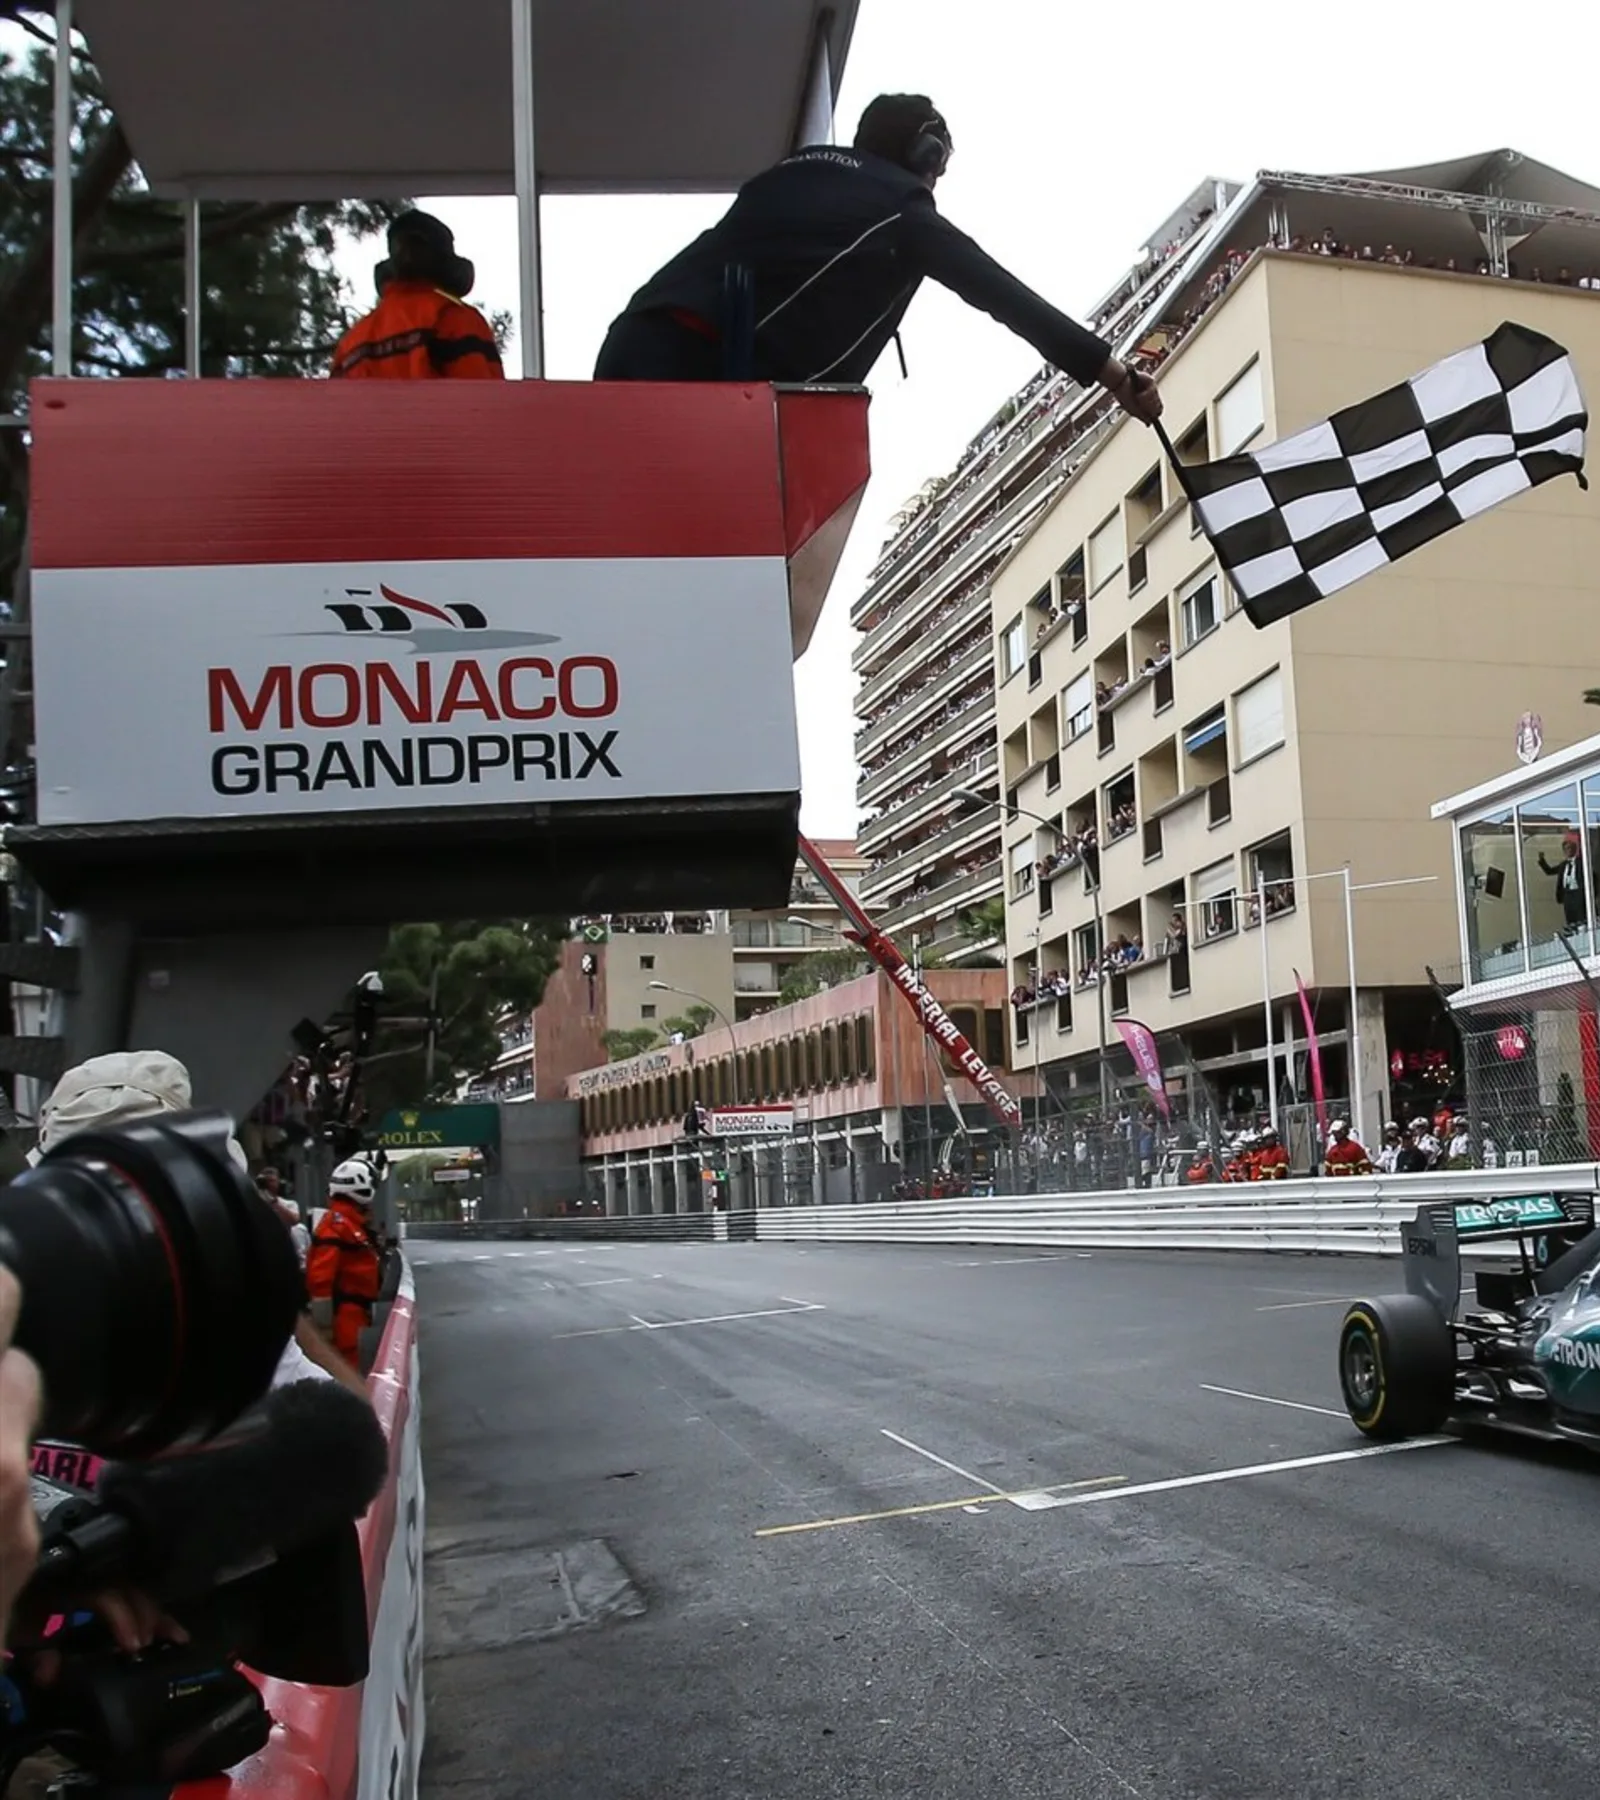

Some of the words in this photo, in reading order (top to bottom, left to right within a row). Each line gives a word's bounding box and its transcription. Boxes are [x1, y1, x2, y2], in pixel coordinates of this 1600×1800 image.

[207, 655, 619, 733] MONACO
[211, 730, 622, 795] GRANDPRIX
[894, 963, 962, 1047] IMPERIAL
[959, 1047, 1018, 1117] LEVAGE
[715, 1115, 765, 1126] MONACO
